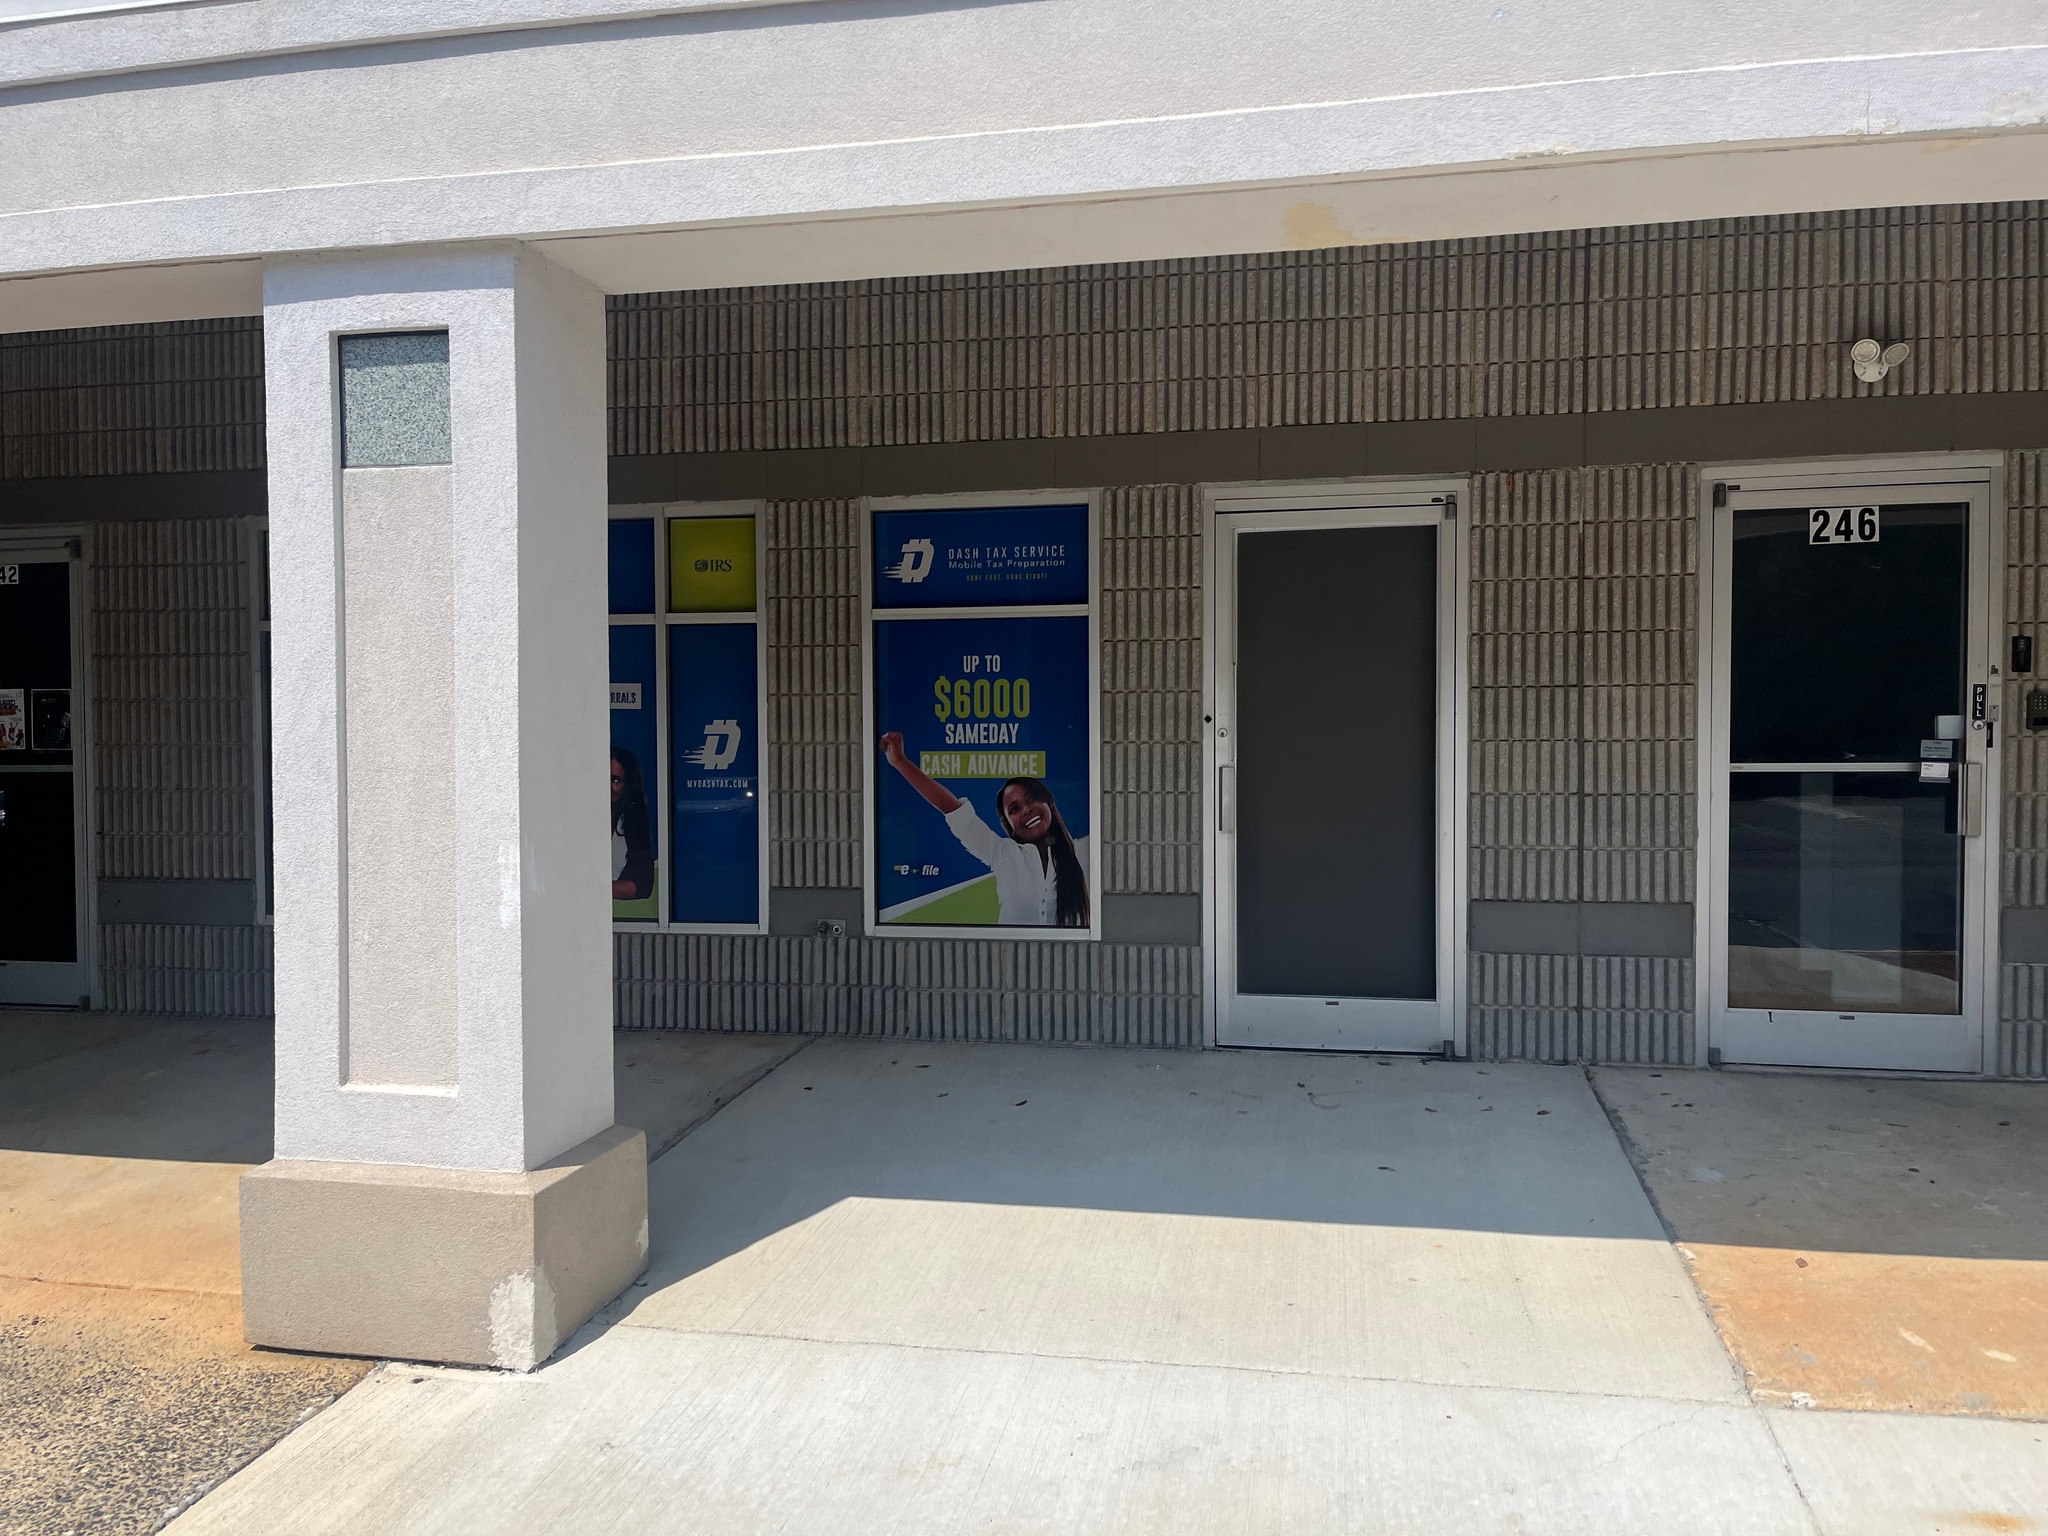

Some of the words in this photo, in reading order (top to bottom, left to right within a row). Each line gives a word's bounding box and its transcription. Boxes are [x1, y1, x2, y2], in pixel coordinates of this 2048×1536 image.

[1812, 507, 1876, 543] 246
[948, 547, 979, 560] DASH
[985, 547, 1007, 559] TAX
[1014, 545, 1065, 558] SERVICE
[710, 559, 732, 572] IRS
[948, 560, 982, 569] Mobile
[986, 559, 1003, 568] Tax
[1007, 558, 1065, 569] Preparation
[963, 655, 980, 673] UP
[984, 654, 1001, 673] TO
[934, 675, 1030, 722] $6000
[945, 723, 1019, 745] SAMEDAY
[920, 753, 961, 776] CASH
[967, 753, 1038, 776] ADVANCE
[686, 779, 748, 788] MYDASHTAX.COM
